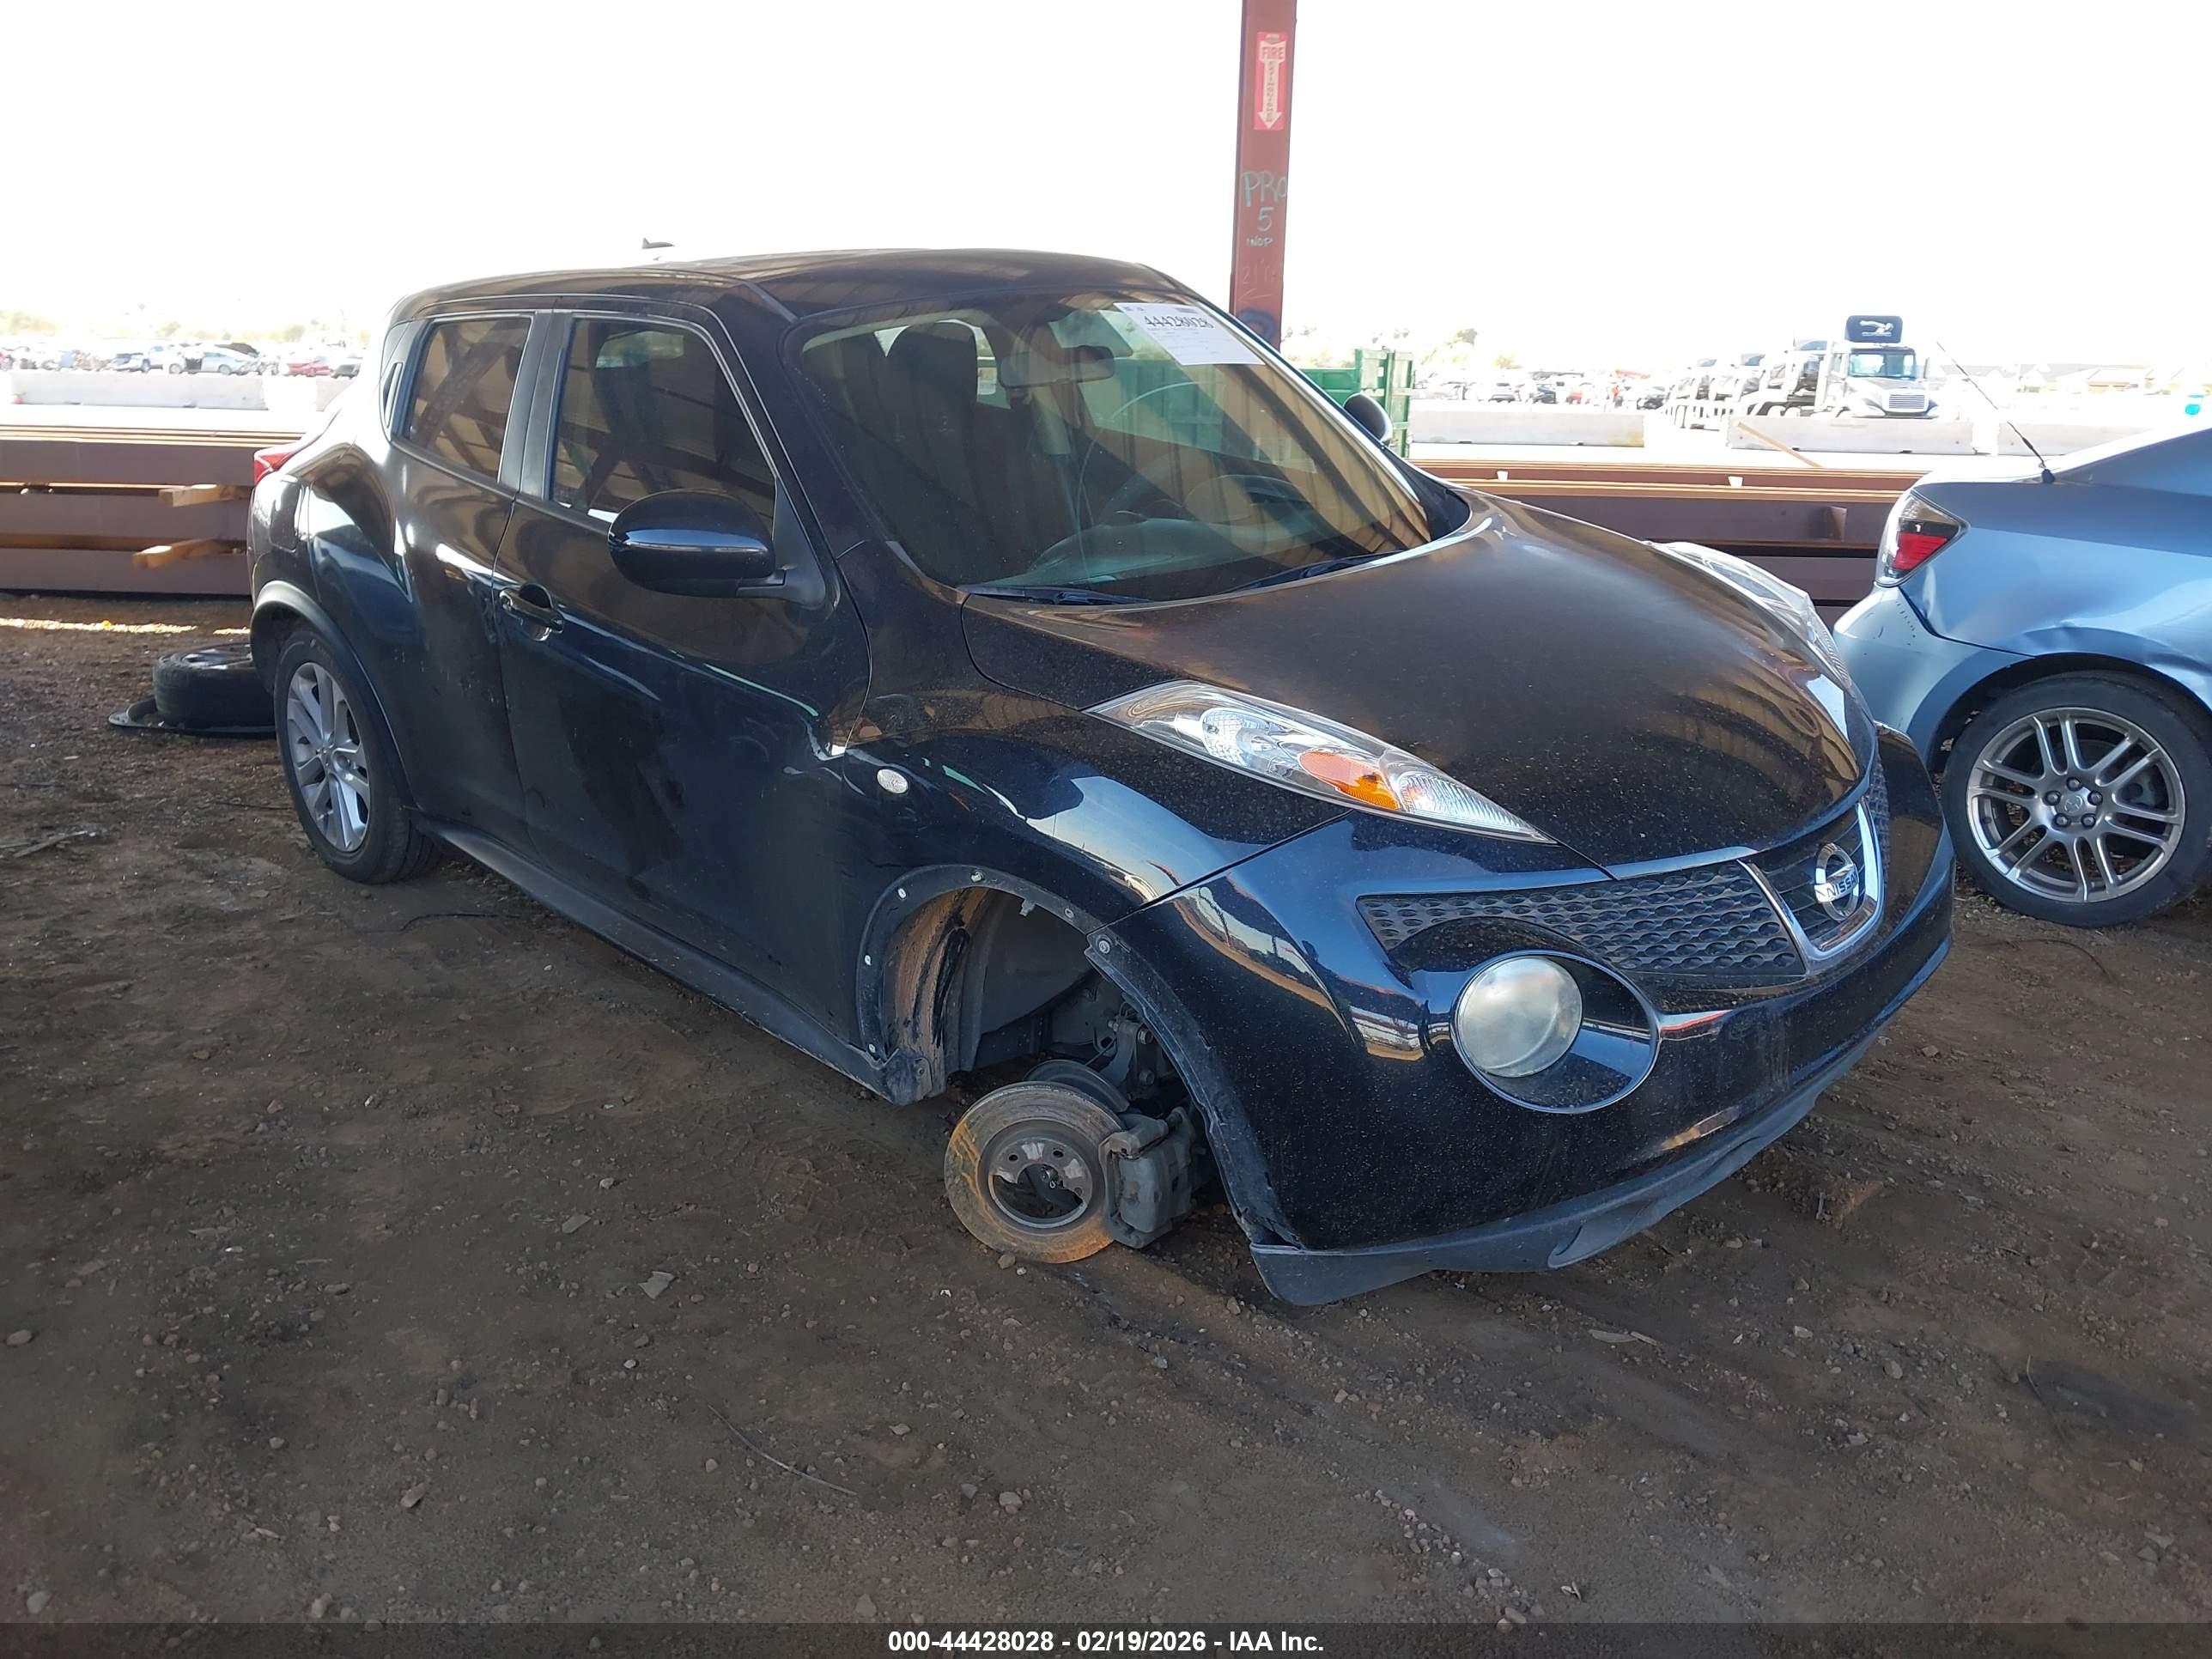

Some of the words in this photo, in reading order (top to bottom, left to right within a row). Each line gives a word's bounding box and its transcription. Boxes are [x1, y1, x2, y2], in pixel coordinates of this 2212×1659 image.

[1261, 46, 1285, 60] FIRE
[1256, 206, 1274, 233] 5
[1144, 315, 1215, 329] 44428028
